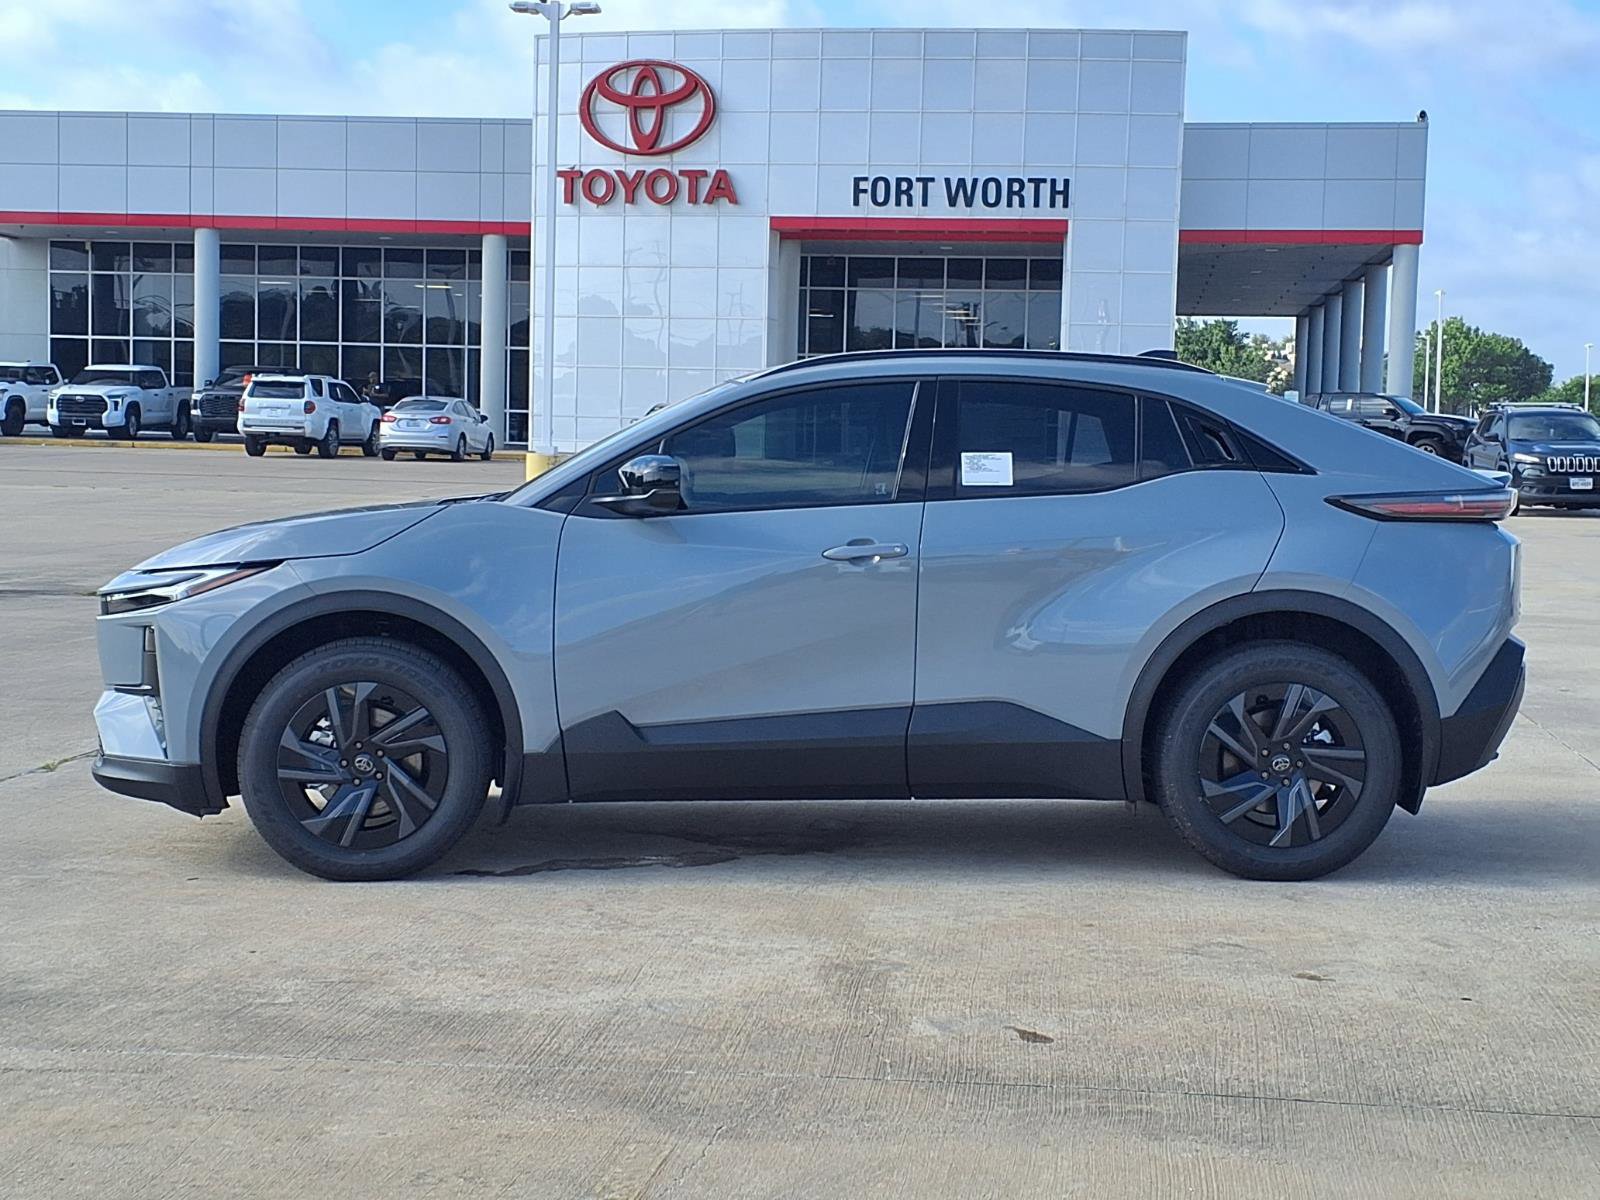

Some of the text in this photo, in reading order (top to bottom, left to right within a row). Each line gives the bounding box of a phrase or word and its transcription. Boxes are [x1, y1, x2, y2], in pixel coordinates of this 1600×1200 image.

[556, 168, 738, 206] TOYOTA
[852, 176, 1070, 208] FORT WORTH
